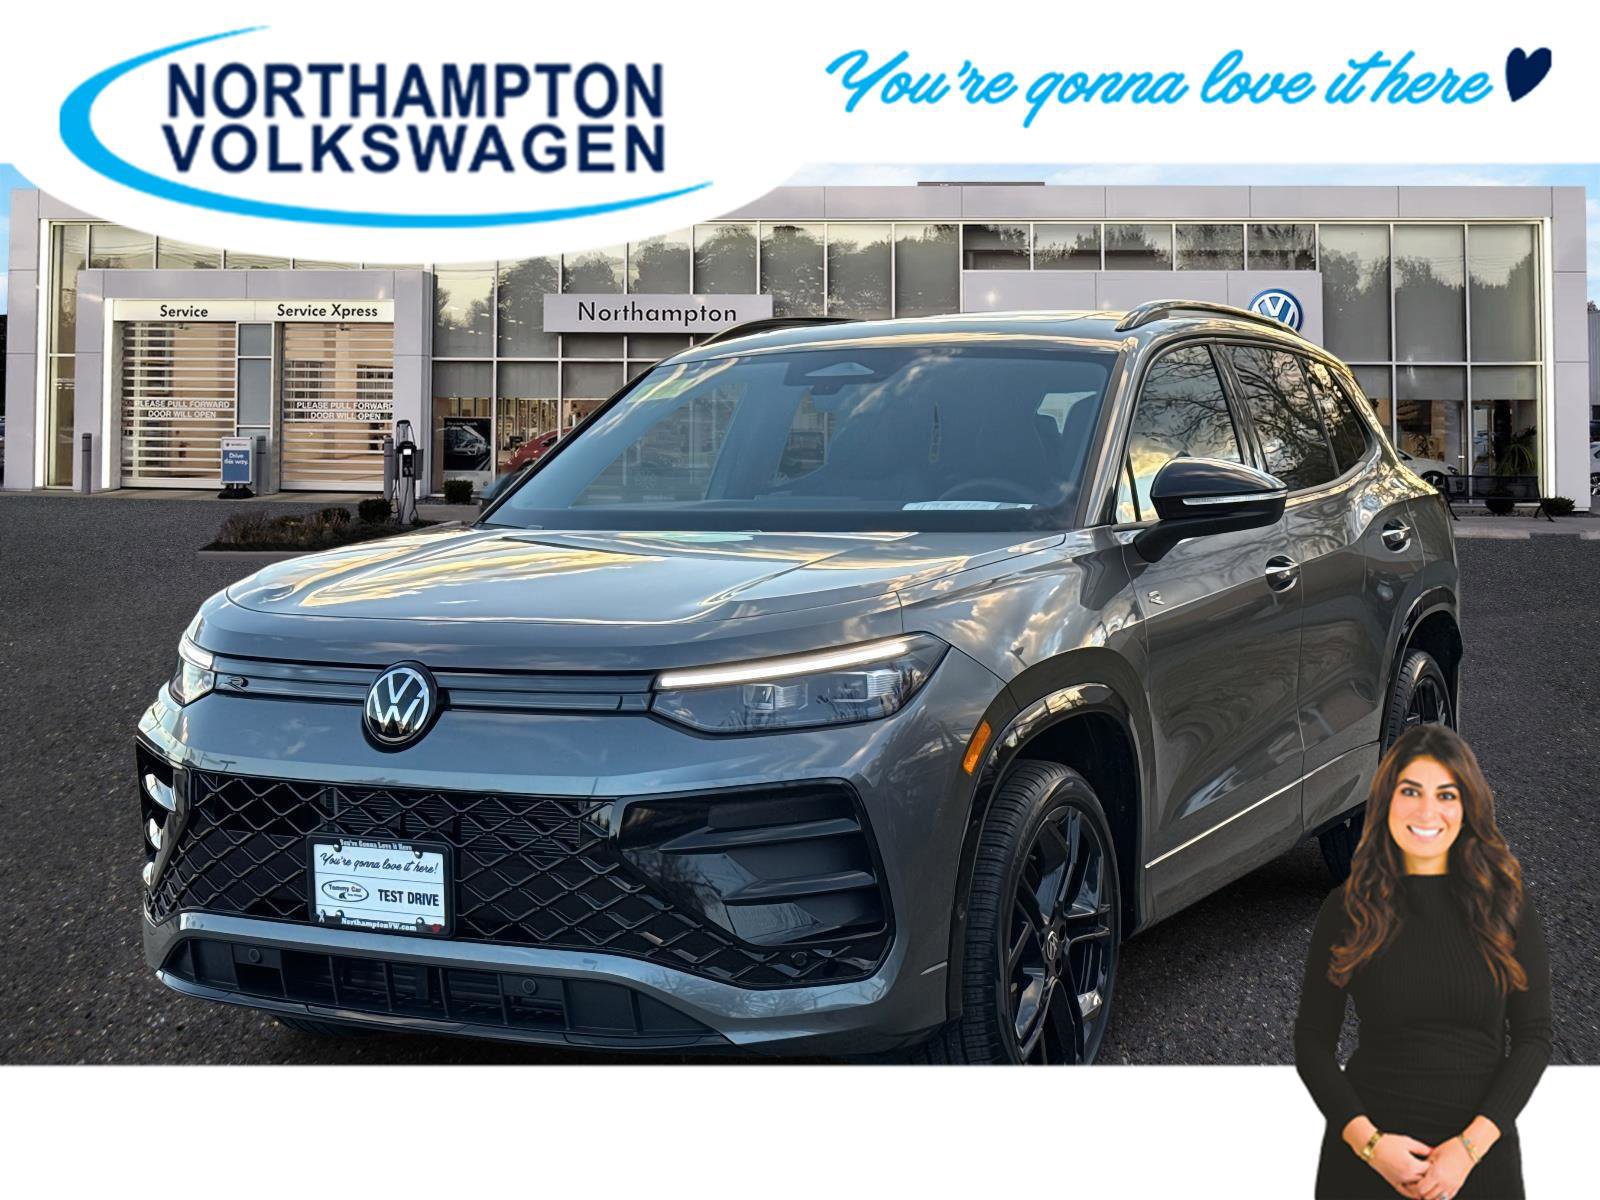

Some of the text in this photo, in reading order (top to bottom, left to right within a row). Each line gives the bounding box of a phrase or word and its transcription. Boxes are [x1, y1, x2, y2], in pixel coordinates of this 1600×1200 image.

[159, 305, 209, 318] Service
[277, 304, 378, 319] Service Xpress
[578, 301, 737, 327] Northampton
[135, 400, 230, 409] PLEASE PULL FORWARD
[296, 401, 328, 409] PLEASE
[330, 401, 352, 409] PULL
[148, 410, 217, 419] DOOR WILL OPEN
[358, 412, 381, 420] OPEN
[320, 852, 352, 867] You're
[353, 860, 381, 872] gonna
[382, 858, 402, 870] love
[403, 861, 415, 872] it
[377, 888, 440, 907] TEST DRIVE
